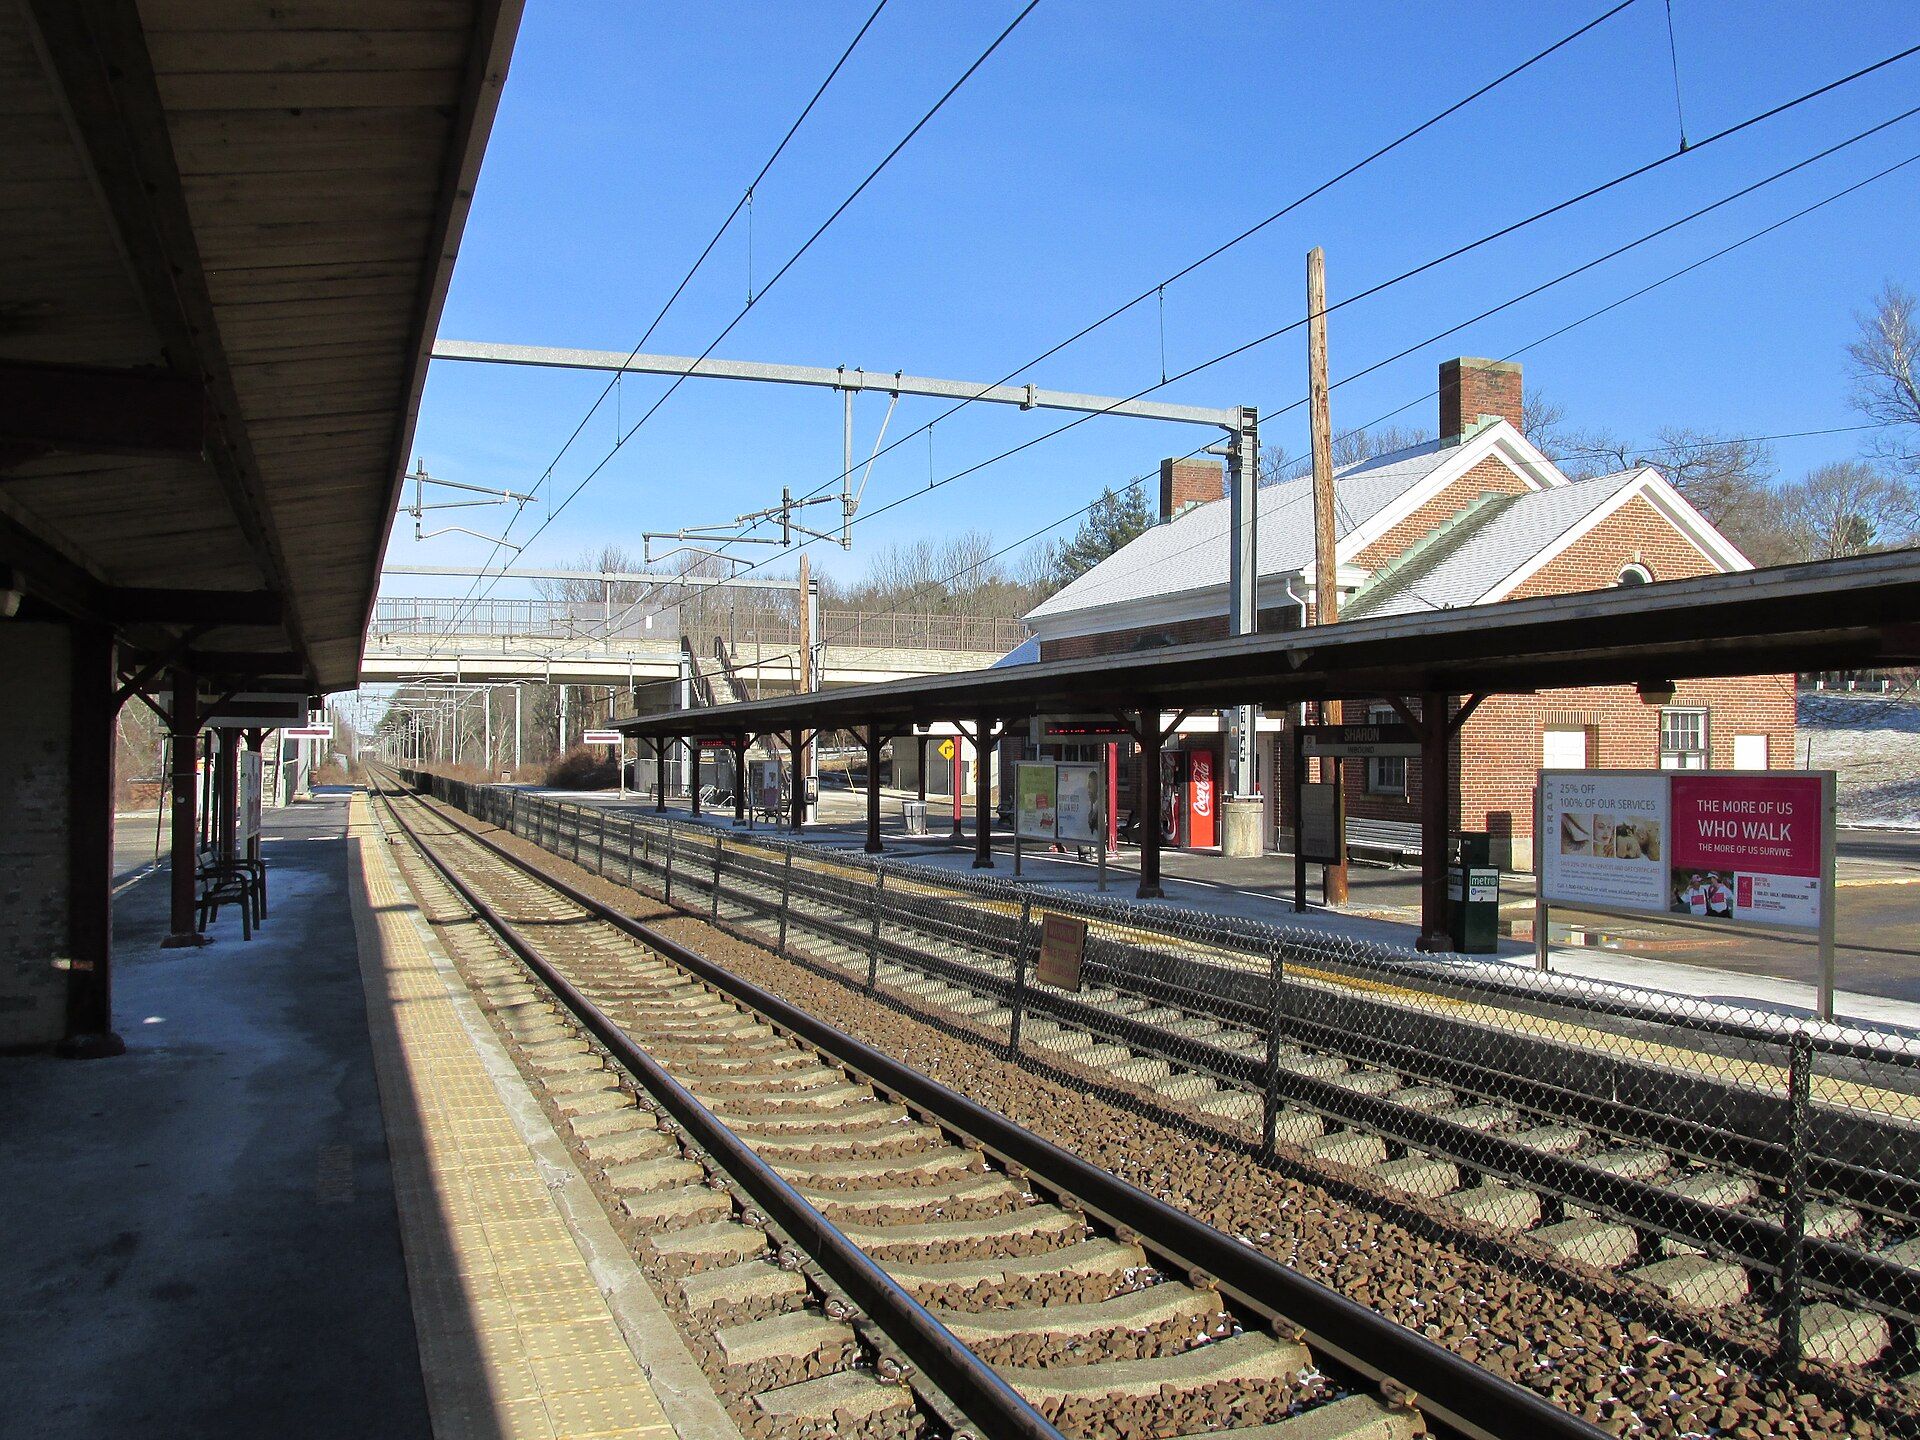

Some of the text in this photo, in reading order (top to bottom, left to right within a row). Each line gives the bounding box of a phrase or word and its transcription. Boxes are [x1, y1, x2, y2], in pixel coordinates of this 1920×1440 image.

[1344, 727, 1380, 741] SHARON
[1347, 746, 1375, 754] INBOUND
[1560, 784, 1595, 794] 25% OFF
[1546, 781, 1554, 835] GRADY
[1560, 798, 1656, 811] 100% OF OUR SERVICES
[1697, 800, 1793, 815] THE MORE OF US
[1698, 819, 1791, 841] WHO WALK
[1698, 843, 1793, 857] THE MORE OF US SURVIVE.
[1471, 876, 1496, 886] metro
